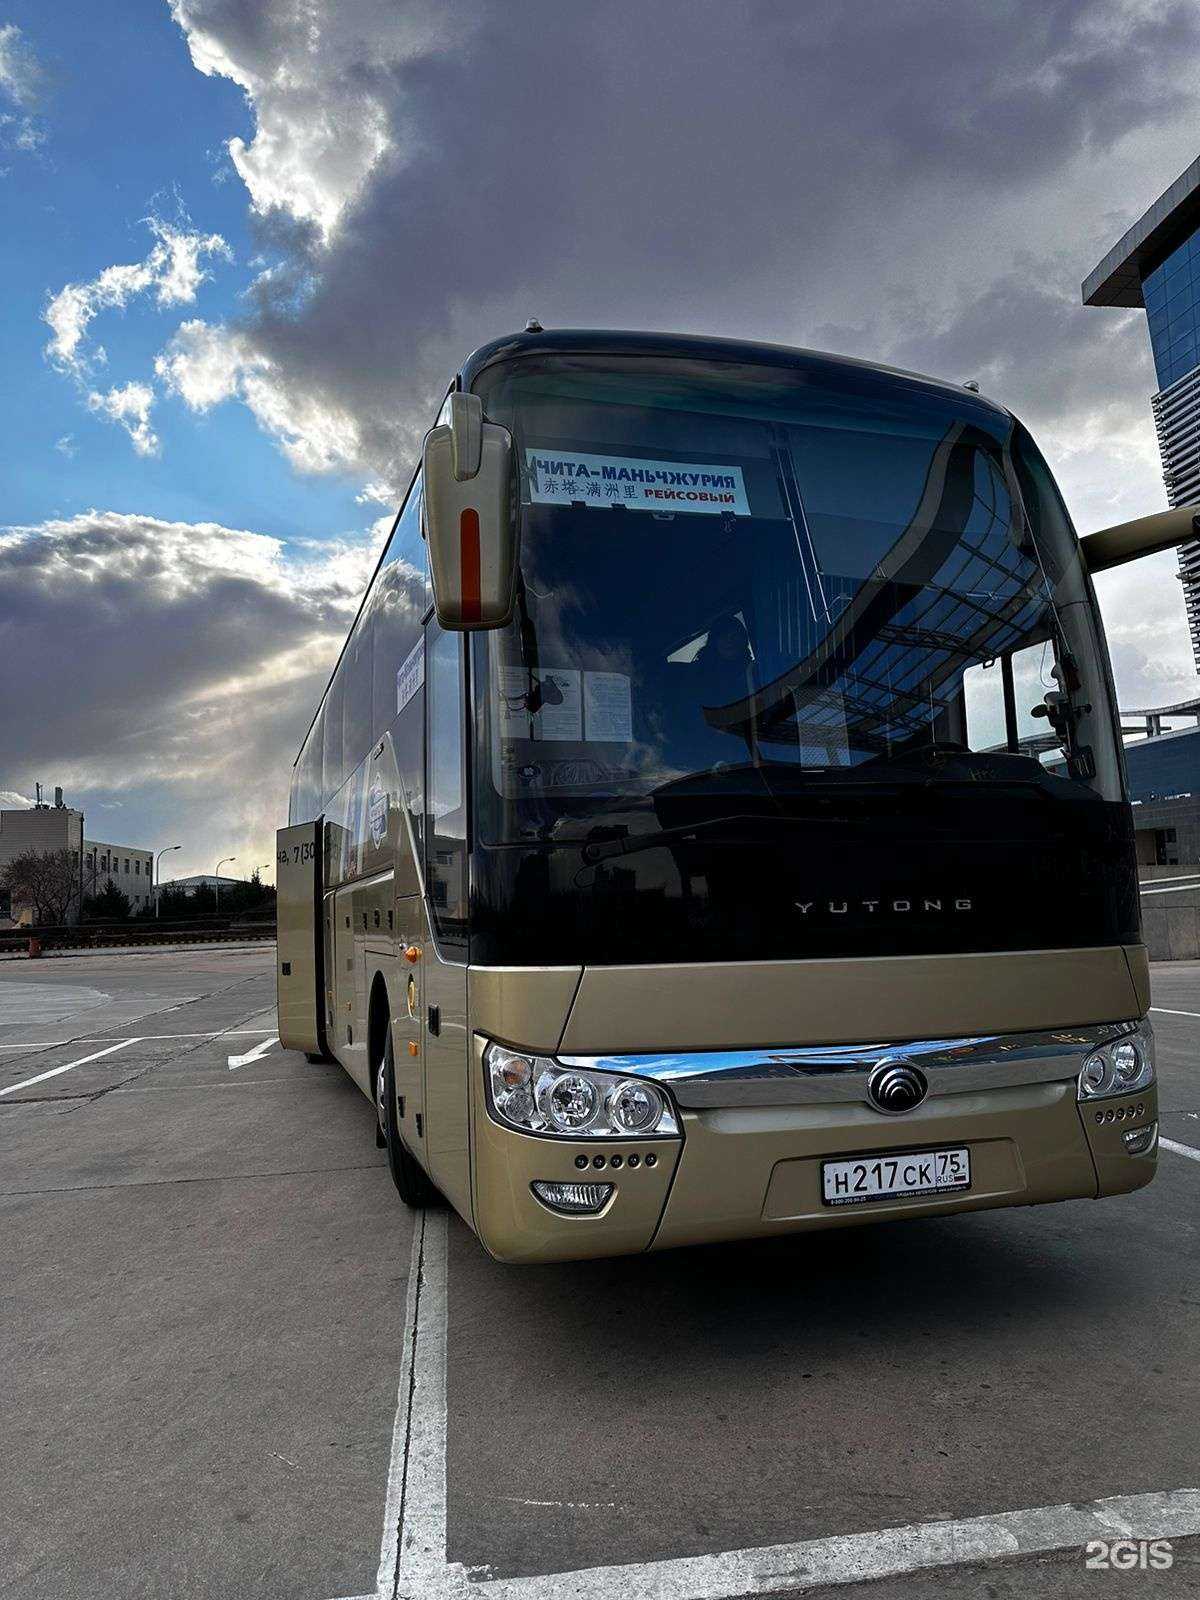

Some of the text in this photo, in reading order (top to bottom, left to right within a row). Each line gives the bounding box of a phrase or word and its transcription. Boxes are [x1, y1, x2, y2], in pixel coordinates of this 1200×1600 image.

[537, 460, 735, 489] ЧИТА-МАНЬЧЖУРИЯ
[643, 488, 735, 504] РЕЙСОВЫЙ
[795, 899, 972, 913] YUTONG
[936, 1174, 954, 1184] RUS
